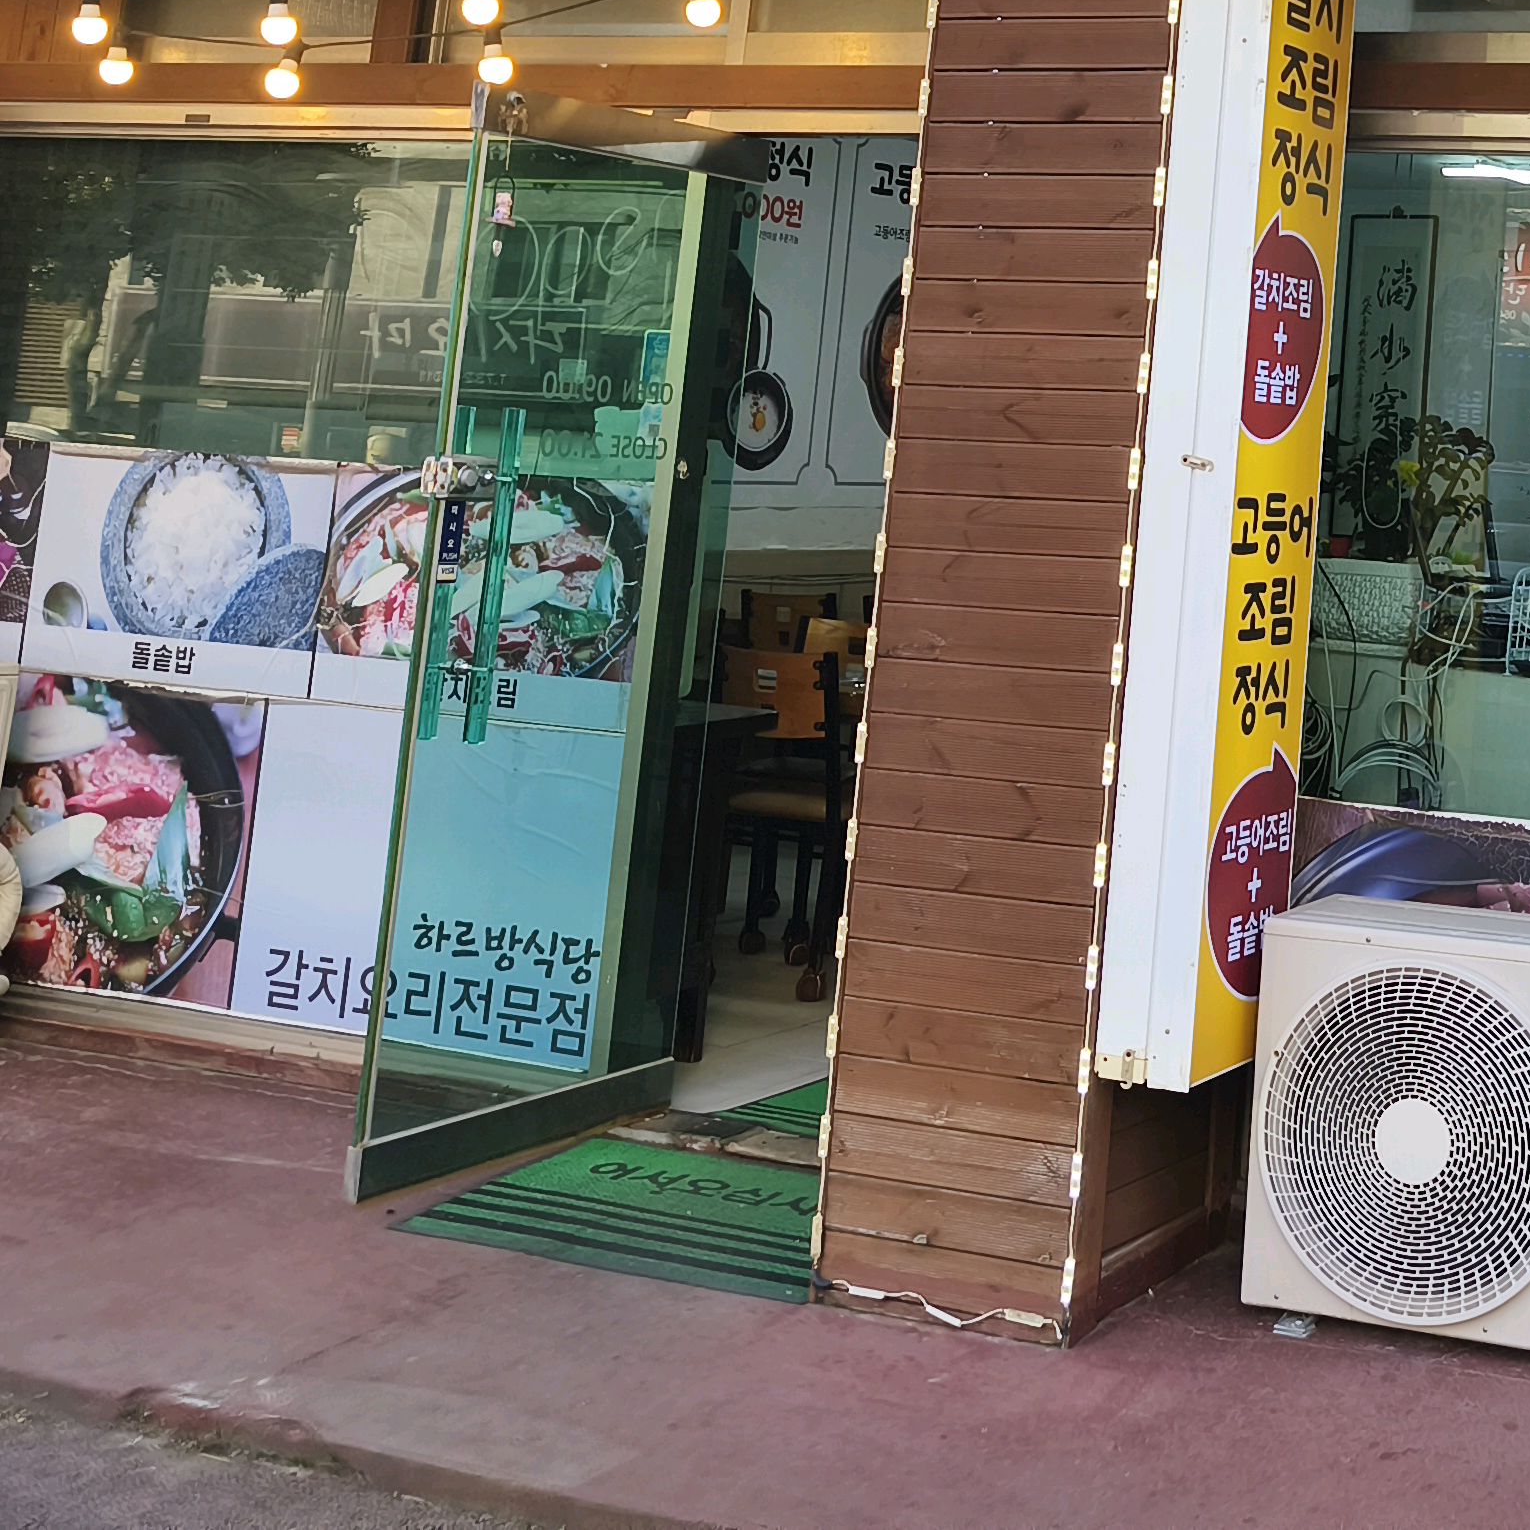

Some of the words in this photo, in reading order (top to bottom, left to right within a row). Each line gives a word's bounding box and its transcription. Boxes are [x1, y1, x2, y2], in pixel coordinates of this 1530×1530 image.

[1277, 43, 1340, 130] 조림
[1271, 127, 1334, 217] 정식
[1253, 267, 1315, 320] 갈치조림
[1254, 360, 1301, 407] 돌솥밥
[1230, 493, 1315, 565] 고등어
[1236, 576, 1297, 647] 조림
[130, 640, 196, 676] 돌솥밥
[1232, 658, 1291, 736] 정식
[1220, 808, 1292, 865] 고등어조림
[411, 912, 601, 986] 하르방식당
[264, 947, 592, 1059] 갈치요리전문점
